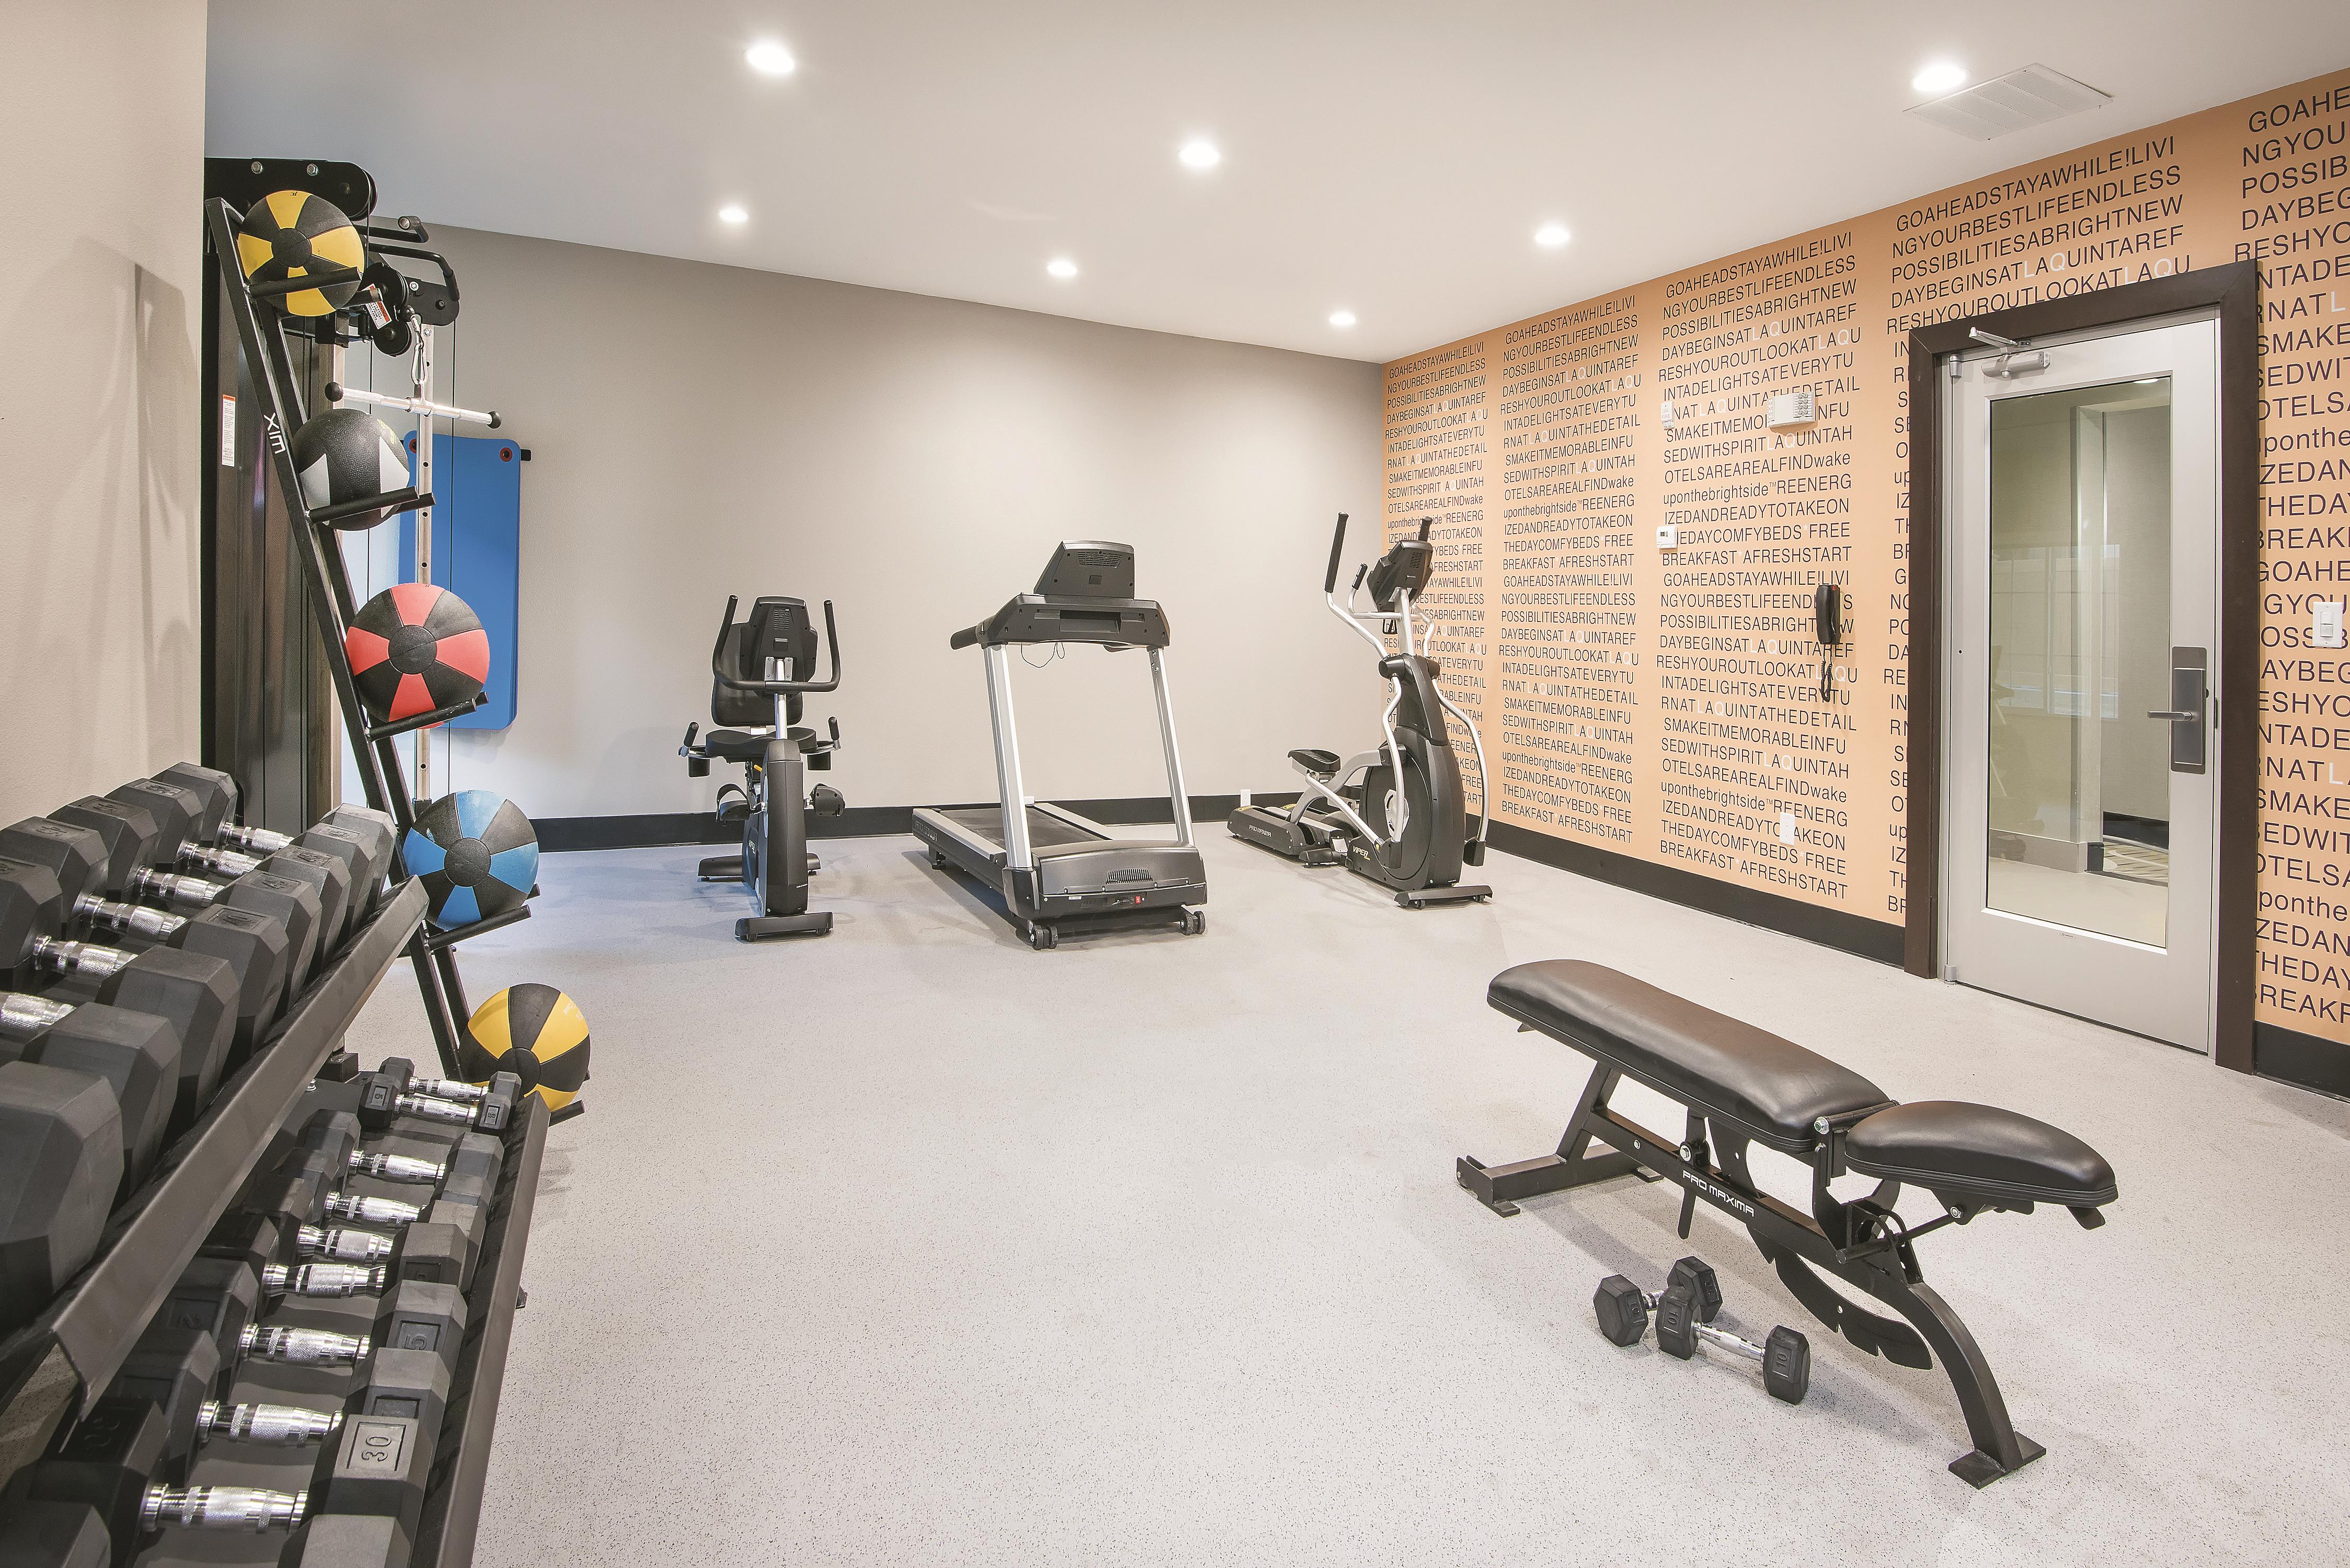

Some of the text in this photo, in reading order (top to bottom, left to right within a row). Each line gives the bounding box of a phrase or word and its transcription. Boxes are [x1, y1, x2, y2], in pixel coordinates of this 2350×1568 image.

[1897, 136, 2173, 231] GOAHEADSTAYAWHILE!LIVI
[1893, 166, 2180, 258] NGYOURBESTLIFEENDLESS
[1893, 194, 2183, 283] POSSIBILITIESABRIGHTNEW
[1667, 232, 1851, 298] GOAHEADSTAYAWHILE!LIVI
[1892, 225, 2183, 308] DAYBEGINSATLAQUINTAREF
[1664, 255, 1855, 320] NGYOURBESTLIFEENDLESS
[1506, 295, 1634, 344] GOAHEADSTAYAWHILE!LIVI
[1663, 279, 1856, 340] POSSIBILITIESABRIGHTNEW
[1504, 315, 1637, 362] NGYOURBESTLIFEENDLESS
[1663, 303, 1856, 361] DAYBEGINSATLAQUINTAREF
[1504, 334, 1638, 380] POSSIBILITIESABRIGHTNEW
[1659, 327, 1860, 382] RESHYOUROUTLOOKATLAQU
[1503, 354, 1638, 397] DAYBEGINSATLAQUINTAREF
[1665, 352, 1852, 401] INTADELIGHTSATEVERYTU
[1501, 374, 1641, 415] RESHYOUROUTLOOKATLAQU
[1505, 394, 1635, 431] INTADELIGHTSATEVERYTU
[1504, 414, 1640, 448] RNATLAQUINTATHEDETAIL
[1664, 425, 1851, 463] SEDWITHSPIRITLAQUINTAH
[1506, 435, 1632, 466] SMAKEITMEMORABLEINFU
[1665, 451, 1850, 483] OTELSAREAREALFINDwake
[1504, 454, 1634, 483] SEDWITHSPIRITLAQUINTAH
[1505, 476, 1633, 500] OTELSAREAREALFINDwake
[1505, 514, 1632, 535] IZEDANDREADYTOTAKEON
[1666, 498, 1848, 524] IZEDANDREADYTOTAKEON
[1504, 573, 1632, 587] GOAHEADSTAYAWHILE!LIVI
[1664, 570, 1848, 587] GOAHEADSTAYAWHILE!LIVI
[1503, 593, 1635, 605] NGYOURBESTLIFEENDLESS
[1502, 611, 1636, 625] POSSIBILITIESABRIGHTNEW
[1502, 628, 1636, 644] DAYBEGINSATLAQUINTAREF
[1499, 645, 1638, 665] RESHYOUROUTLOOKATLAQU
[1503, 662, 1633, 684] INTADELIGHTSATEVERYTU
[1503, 679, 1638, 705] RNATLAQUINTATHEDETAIL
[1505, 697, 1630, 724] SMAKEITMEMORABLEINFU
[1662, 697, 1856, 731] RNATLAQUINTATHEDETAIL
[1503, 714, 1632, 744] SEDWITHSPIRITLAQUINTAH
[1665, 718, 1845, 754] SMAKEITMEMORABLEINFU
[1504, 732, 1631, 764] OTELSAREAREALFINDwake
[1662, 738, 1848, 779] SEDWITHSPIRITLAQUINTAH
[1504, 766, 1630, 803] IZEDANDREADYTOTAKEON
[1663, 759, 1846, 802] OTELSAREAREALFINDwake
[1257, 827, 1271, 837] MAXIMA
[1664, 800, 1844, 850] IZEDANDREADYTOAKEON
[1352, 845, 1369, 857] VIPER
[1682, 1170, 1755, 1217] PRO MAXIMA
[1668, 1310, 1679, 1327] 10
[1776, 1352, 1789, 1369] 10
[361, 1436, 392, 1462] 30
